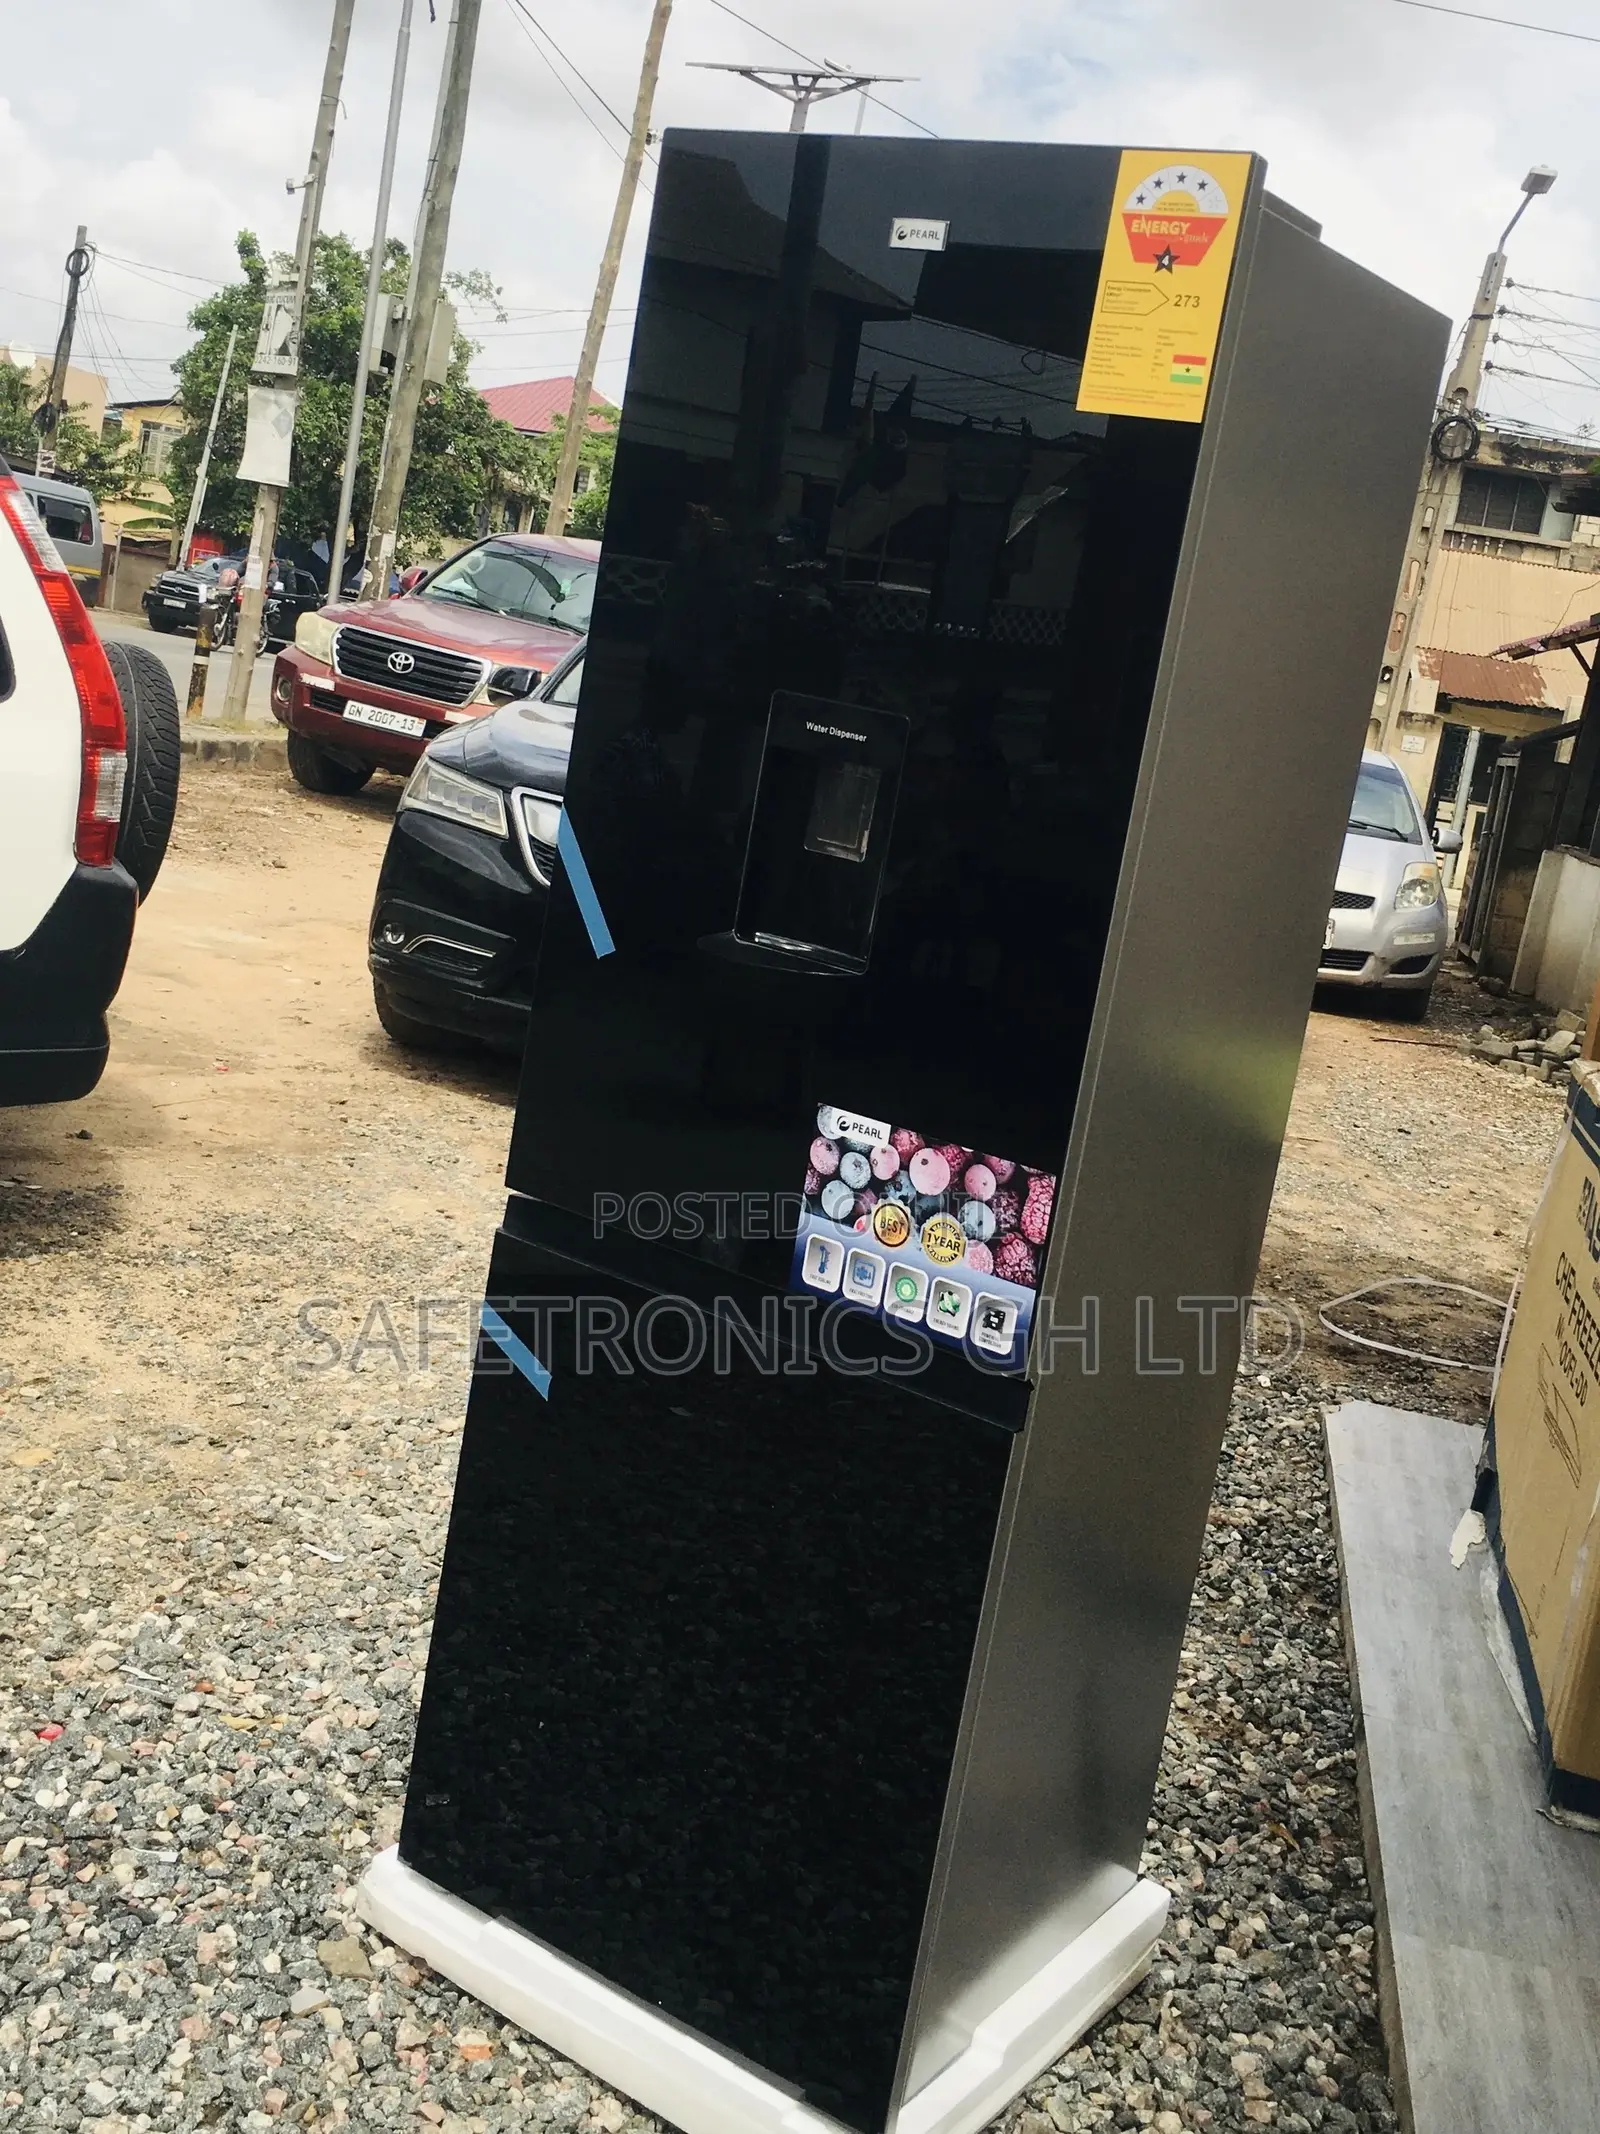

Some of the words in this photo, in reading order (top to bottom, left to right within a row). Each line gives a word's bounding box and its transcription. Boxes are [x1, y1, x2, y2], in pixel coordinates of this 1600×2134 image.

[909, 229, 940, 240] PEARL
[1131, 214, 1191, 238] ENERGY
[1162, 255, 1170, 266] 4
[1173, 294, 1200, 308] 273
[348, 704, 364, 718] GN
[367, 708, 416, 731] 2007-13
[806, 721, 829, 734] Water
[829, 726, 867, 742] Dispenser
[851, 1122, 883, 1140] PEARL
[880, 1215, 905, 1236] BEST
[927, 1232, 932, 1243] 1
[933, 1234, 961, 1252] YEAR
[1568, 1290, 1600, 1386] FREEZE
